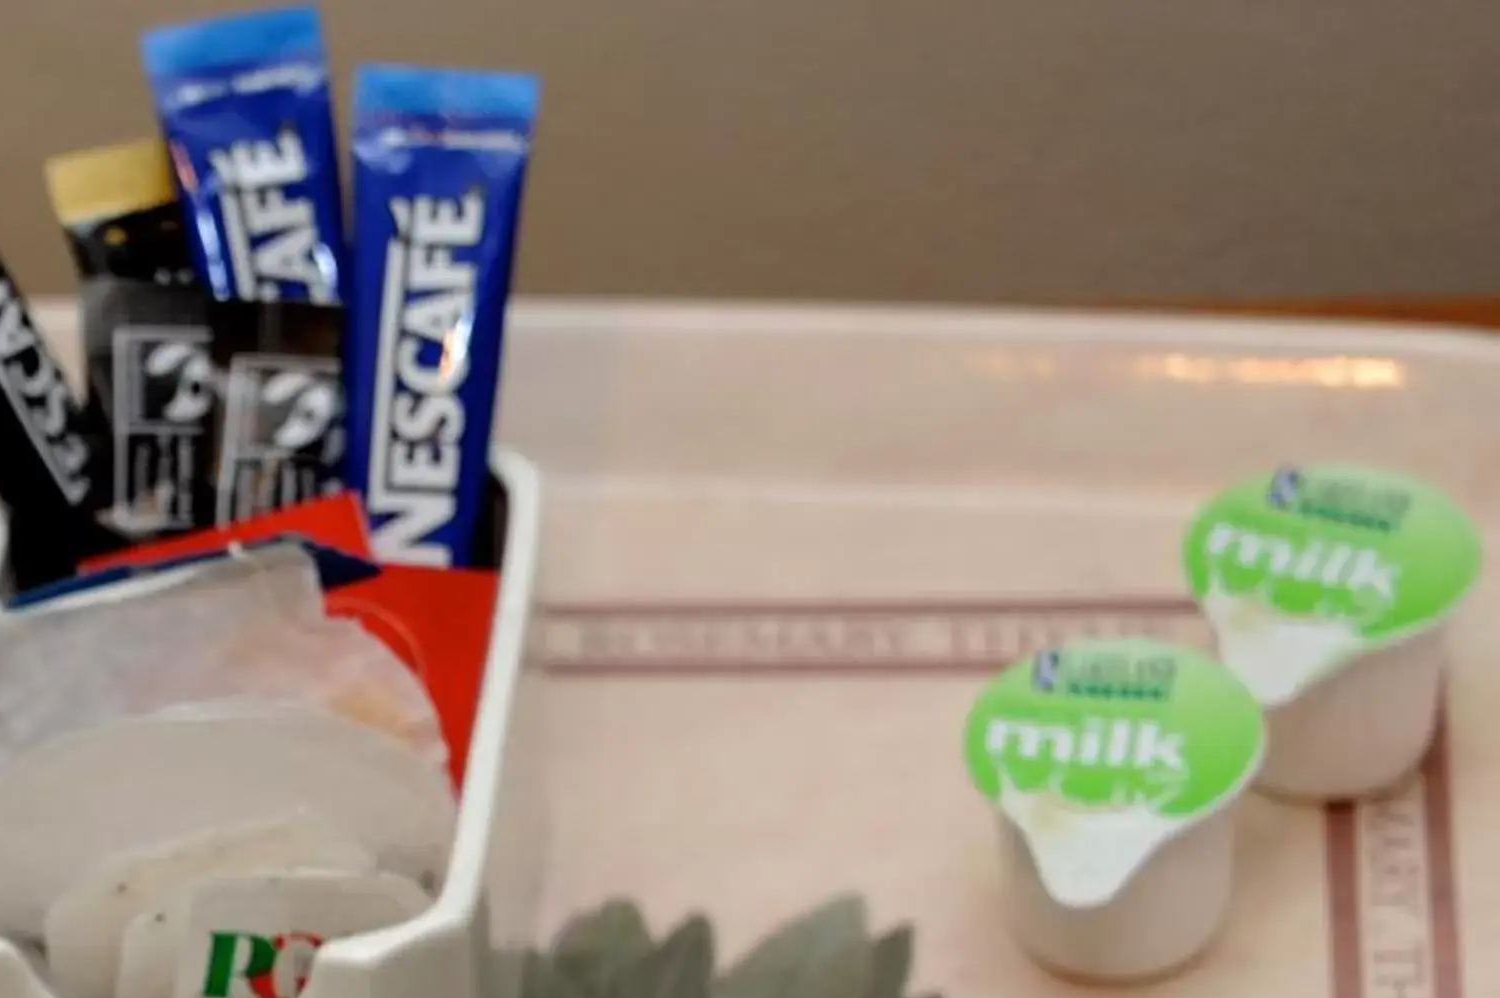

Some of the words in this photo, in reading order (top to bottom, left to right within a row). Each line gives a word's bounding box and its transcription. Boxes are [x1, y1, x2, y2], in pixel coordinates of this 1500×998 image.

[367, 184, 486, 568] NESCAFÉ
[1208, 522, 1400, 600] milk
[986, 716, 1186, 770] milk
